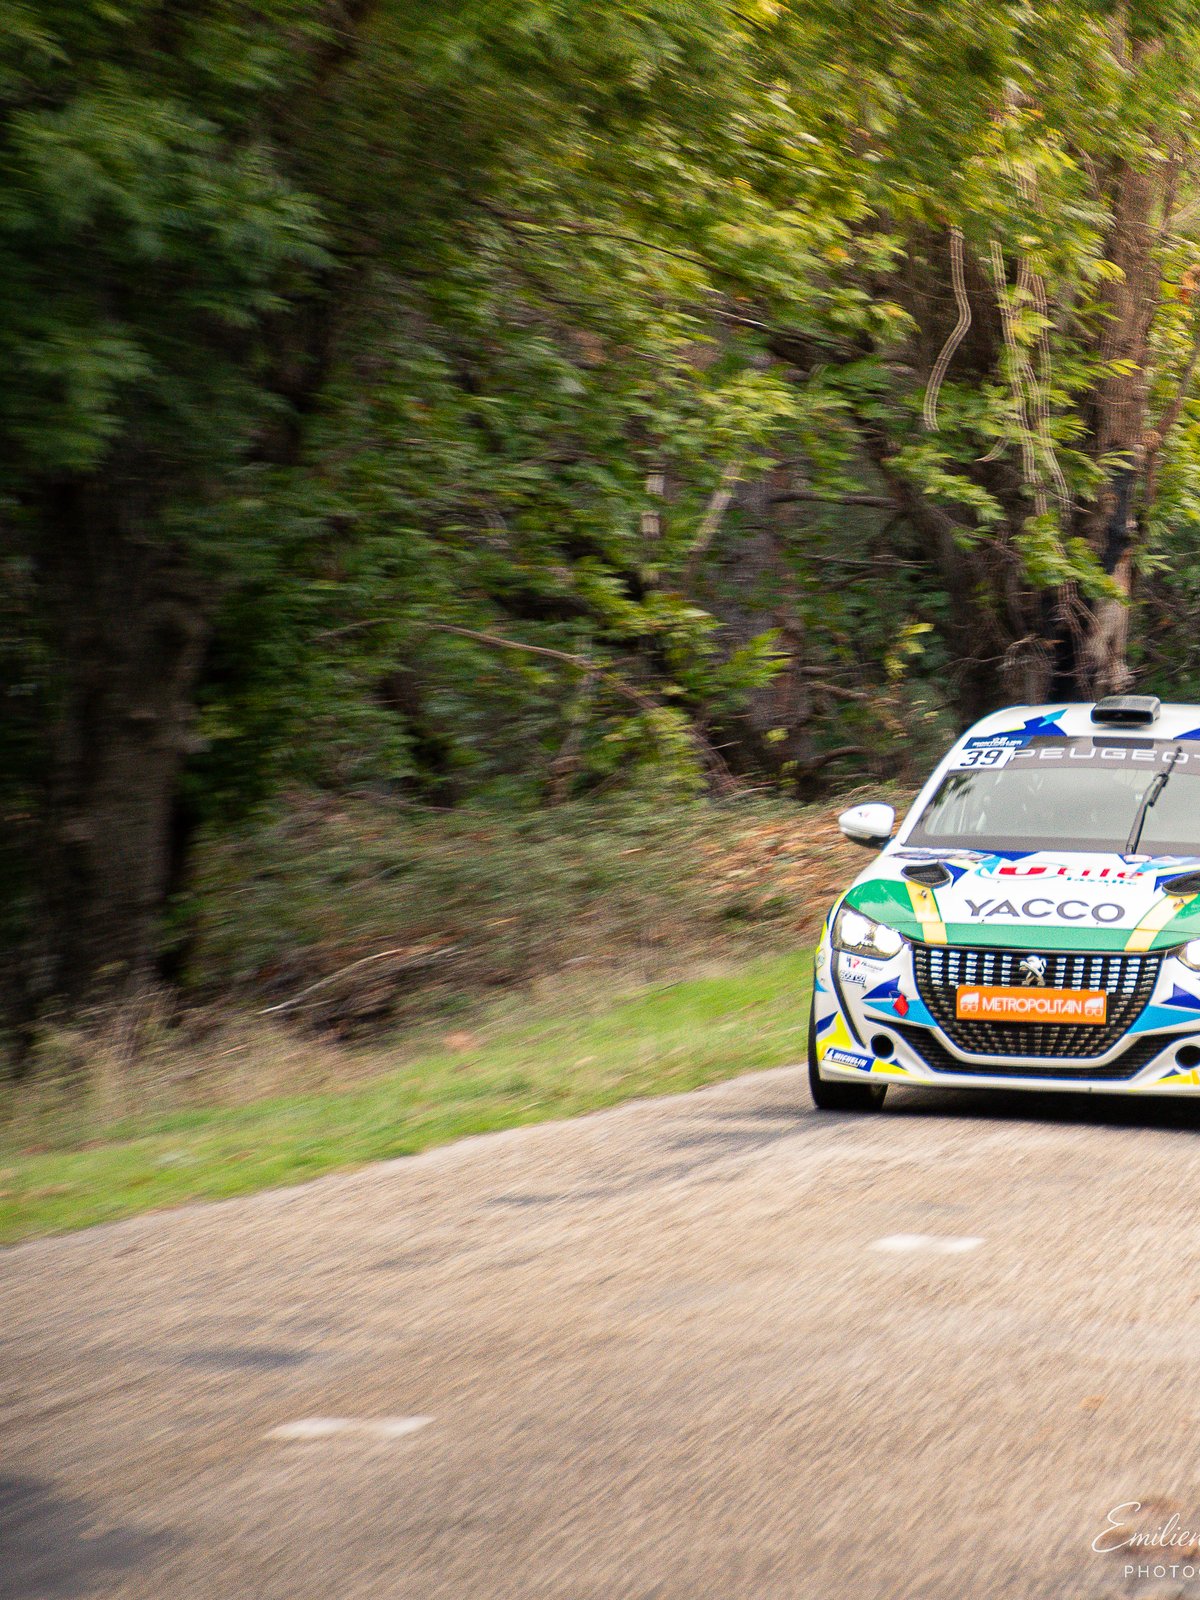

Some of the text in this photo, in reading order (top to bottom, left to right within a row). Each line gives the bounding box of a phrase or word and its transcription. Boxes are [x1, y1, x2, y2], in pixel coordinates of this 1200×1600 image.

[959, 749, 1004, 767] 39
[964, 898, 1126, 923] YACCO
[982, 996, 1083, 1015] METROPOLITAN
